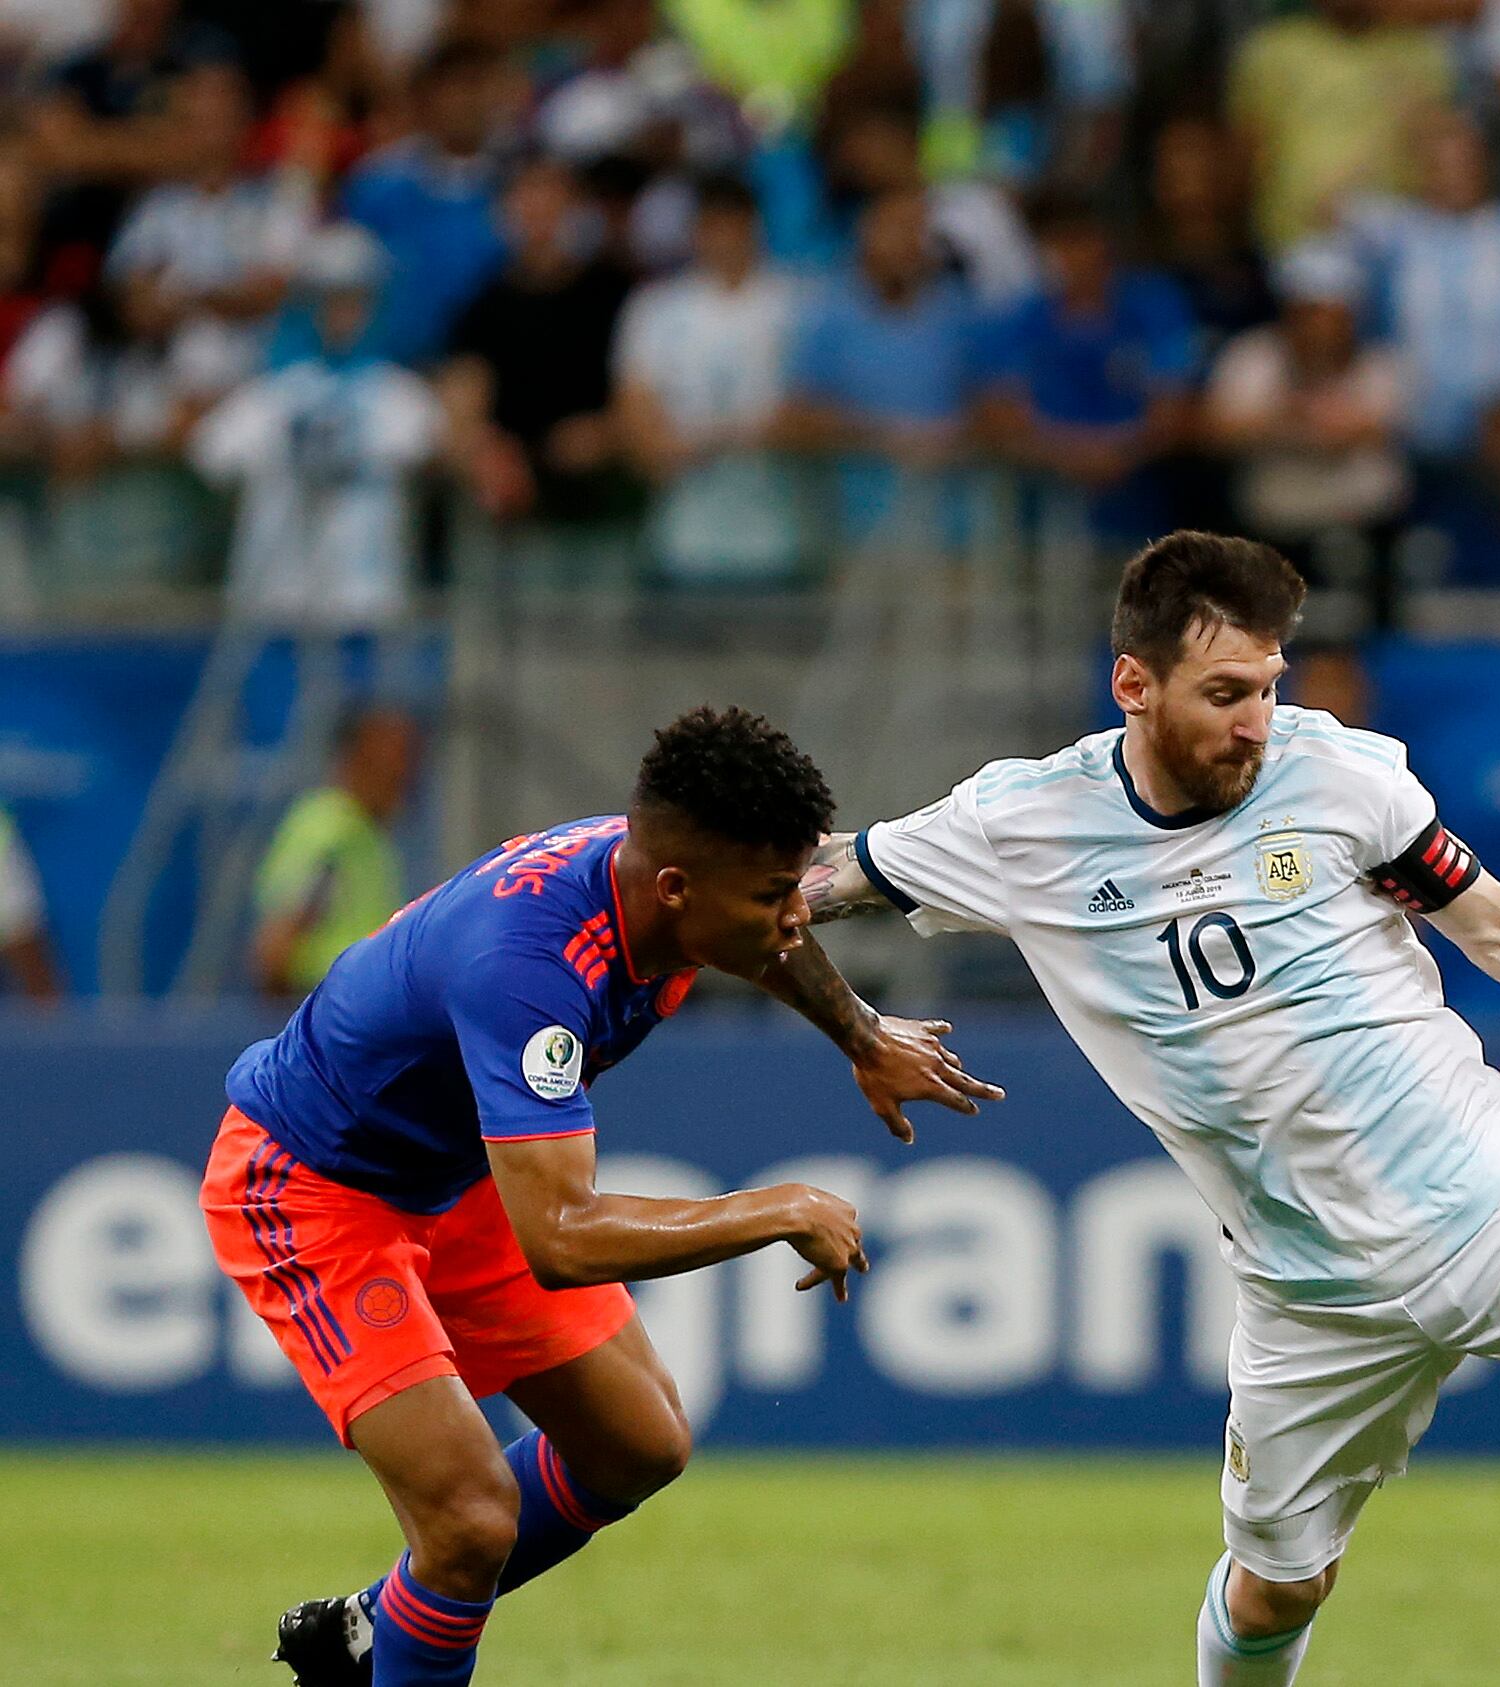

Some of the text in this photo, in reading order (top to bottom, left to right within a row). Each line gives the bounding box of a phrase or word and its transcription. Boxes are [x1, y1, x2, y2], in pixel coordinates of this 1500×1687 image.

[1269, 851, 1300, 882] AFA
[1088, 899, 1135, 913] adidas
[1156, 911, 1256, 1011] 10
